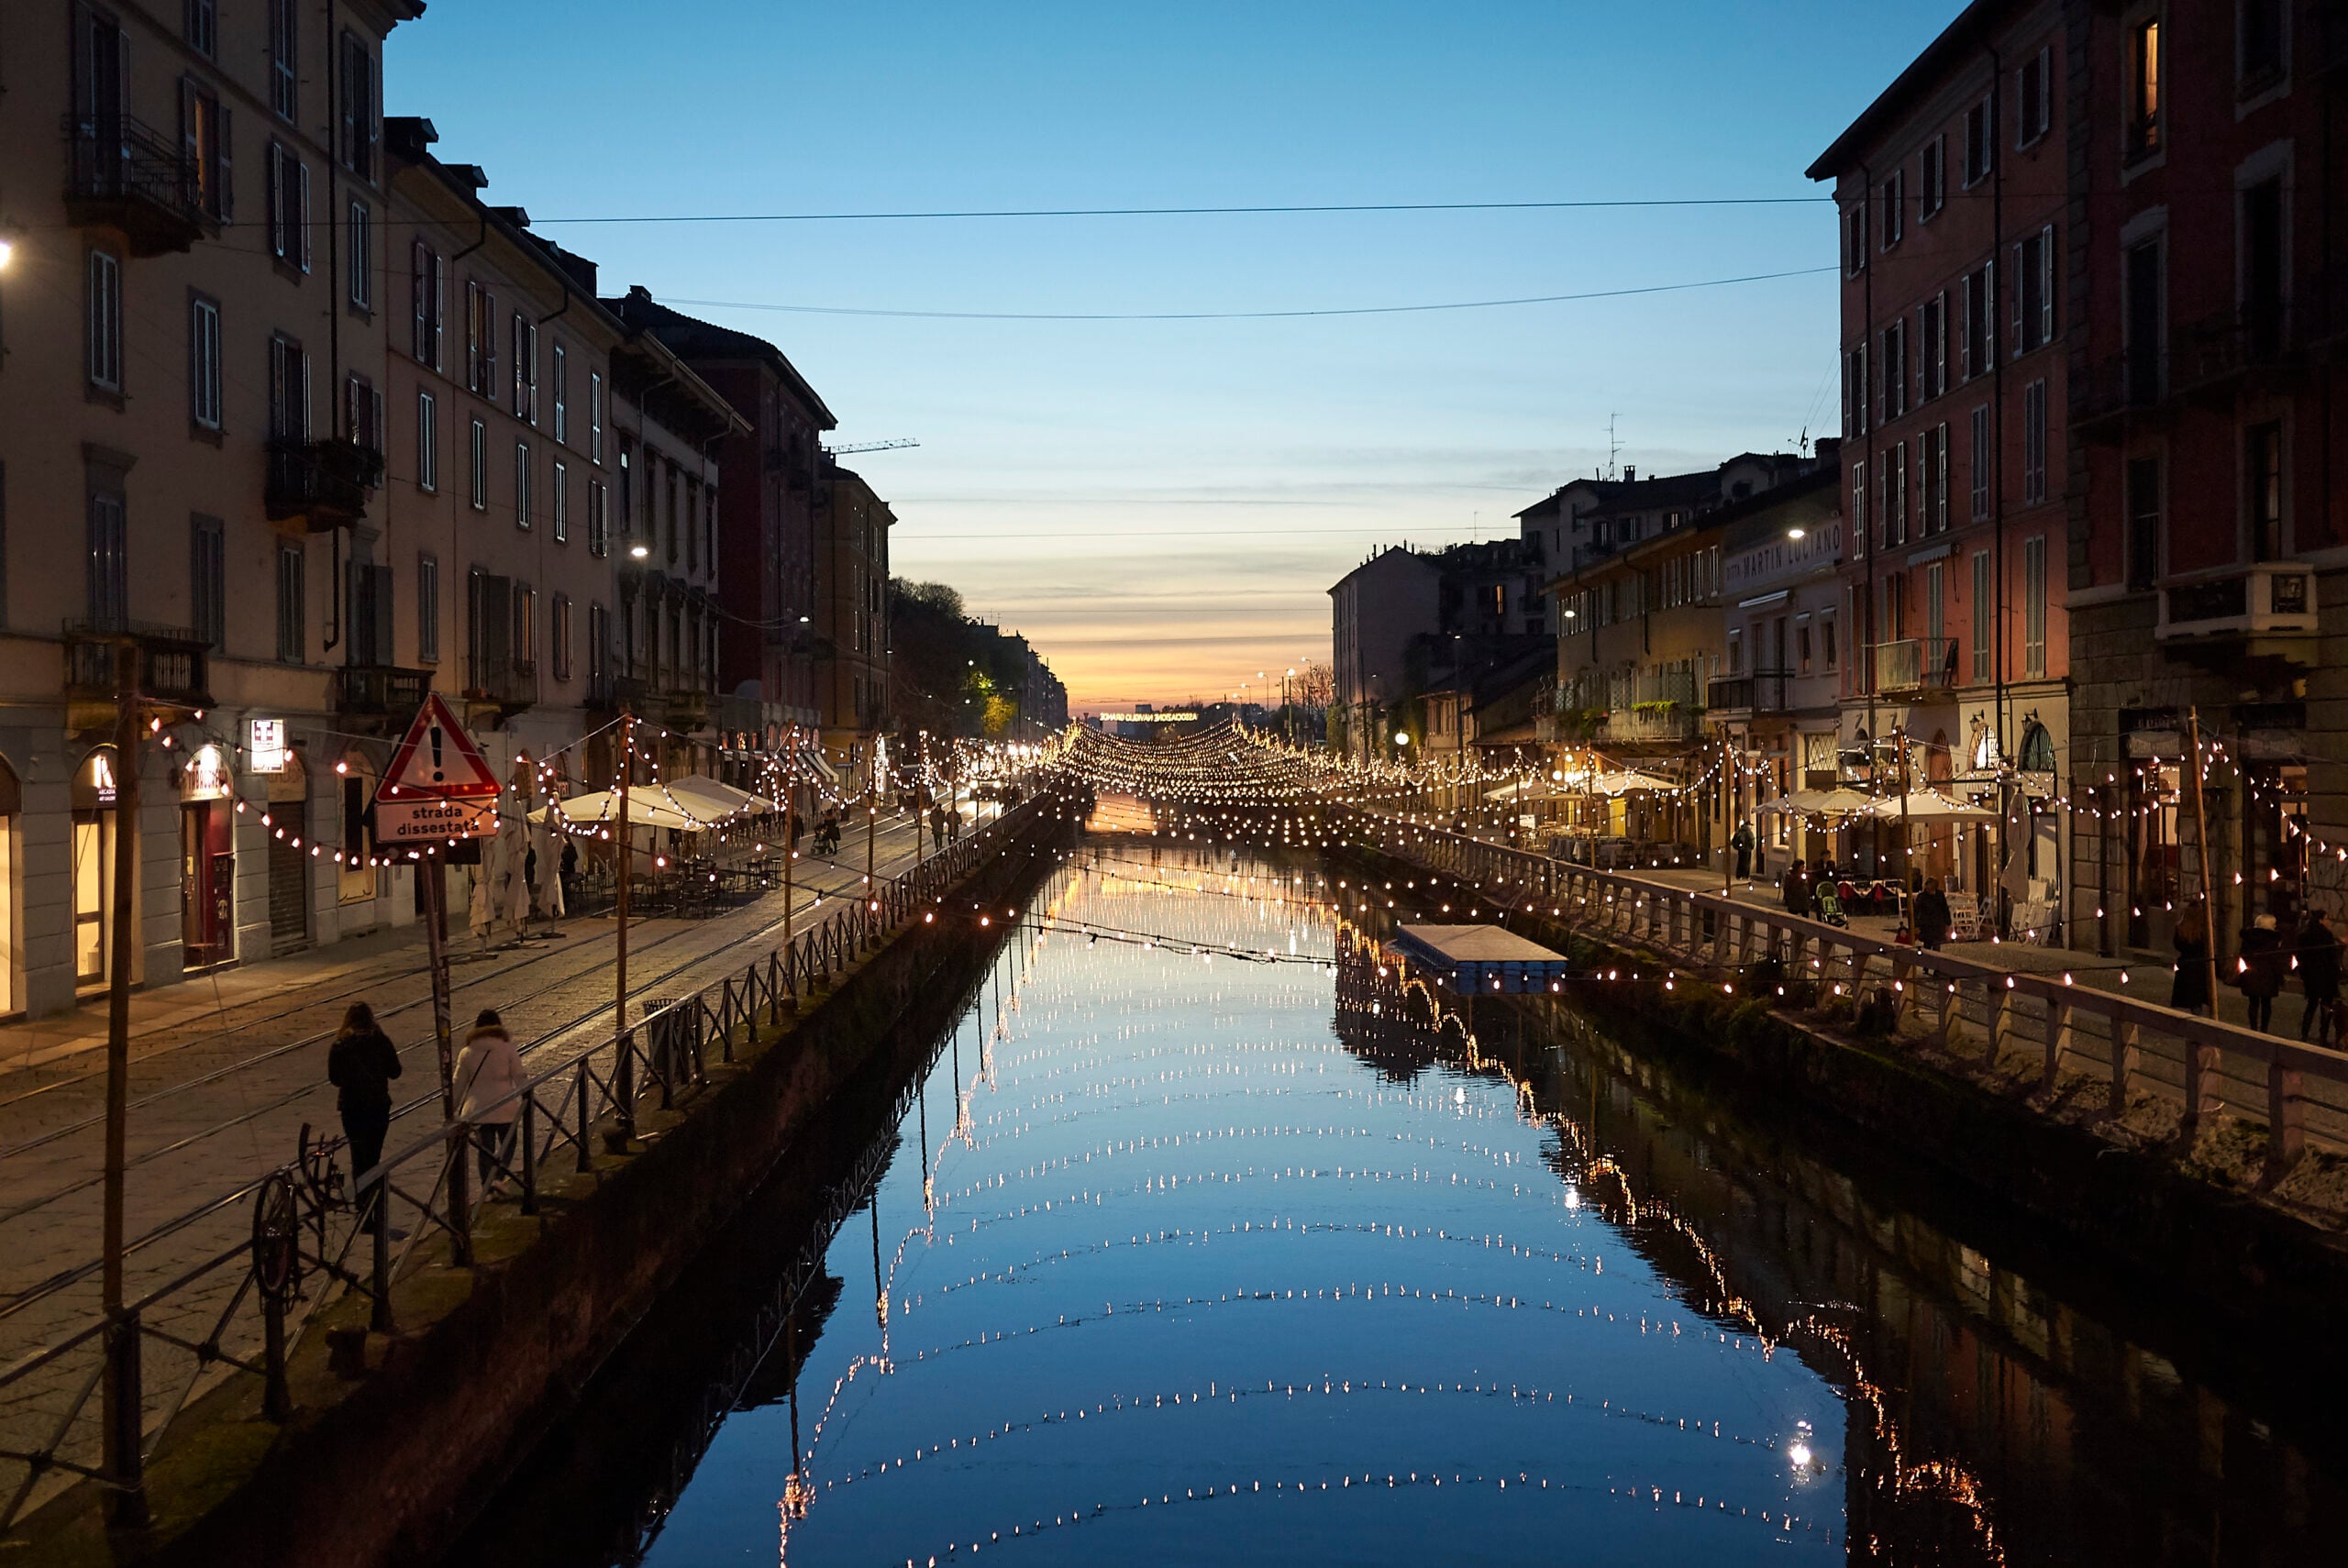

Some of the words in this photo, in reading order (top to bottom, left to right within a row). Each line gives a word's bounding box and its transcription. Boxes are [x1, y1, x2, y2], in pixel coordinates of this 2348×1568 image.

[1743, 545, 1782, 580] MARTIN
[1789, 524, 1841, 565] LUCIANO
[412, 805, 463, 820] strada
[396, 820, 480, 836] dissestata
